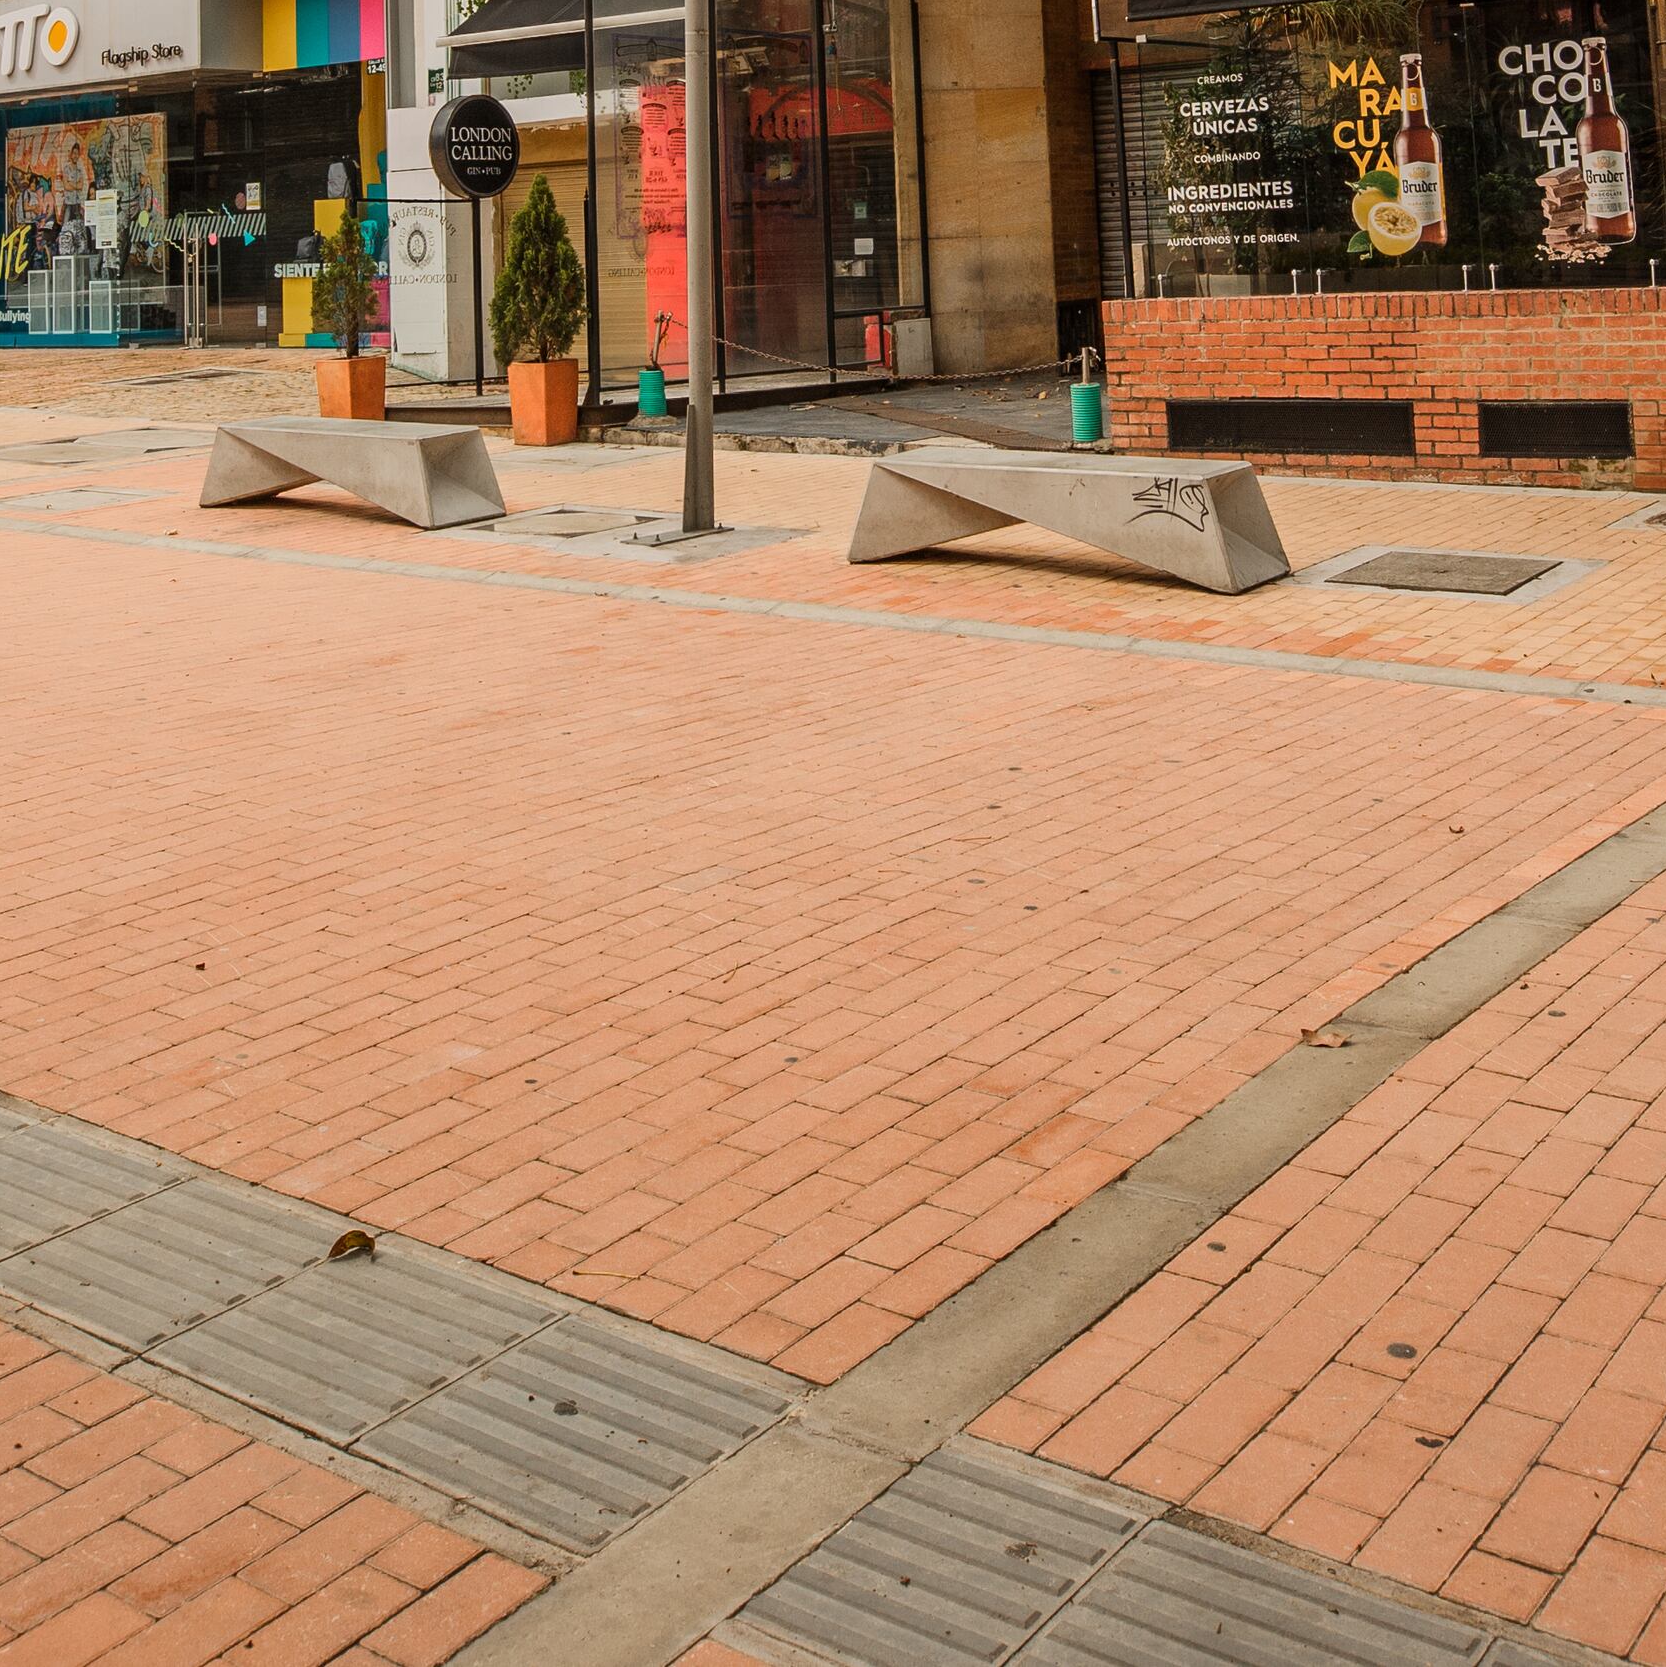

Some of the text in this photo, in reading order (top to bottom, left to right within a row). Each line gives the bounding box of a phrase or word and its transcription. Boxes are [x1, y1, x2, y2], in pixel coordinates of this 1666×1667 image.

[101, 43, 182, 68] Flagship Store
[1498, 40, 1583, 76] CHO
[1197, 73, 1243, 85] CREAMOS
[1328, 57, 1386, 89] MA
[1532, 72, 1587, 104] CO
[1180, 97, 1270, 118] CERVEZAS
[1360, 88, 1401, 117] RA
[1193, 117, 1258, 136] ÚNICAS
[1519, 106, 1568, 138] LA
[451, 127, 511, 142] LONDON
[1333, 119, 1380, 149] CU
[452, 145, 512, 160] CALLING
[1194, 151, 1261, 164] COMBINANDO
[1349, 141, 1398, 180] YÁ
[1539, 138, 1580, 170] TE
[1402, 179, 1437, 193] Bruder
[1585, 169, 1624, 183] Bruder
[1168, 180, 1293, 202] INGREDIENTES
[1168, 199, 1294, 214] NO CONVENCIONALES
[1167, 235, 1231, 247] AUTÓCTONOS
[1234, 235, 1240, 245] Y
[1243, 234, 1257, 244] DE
